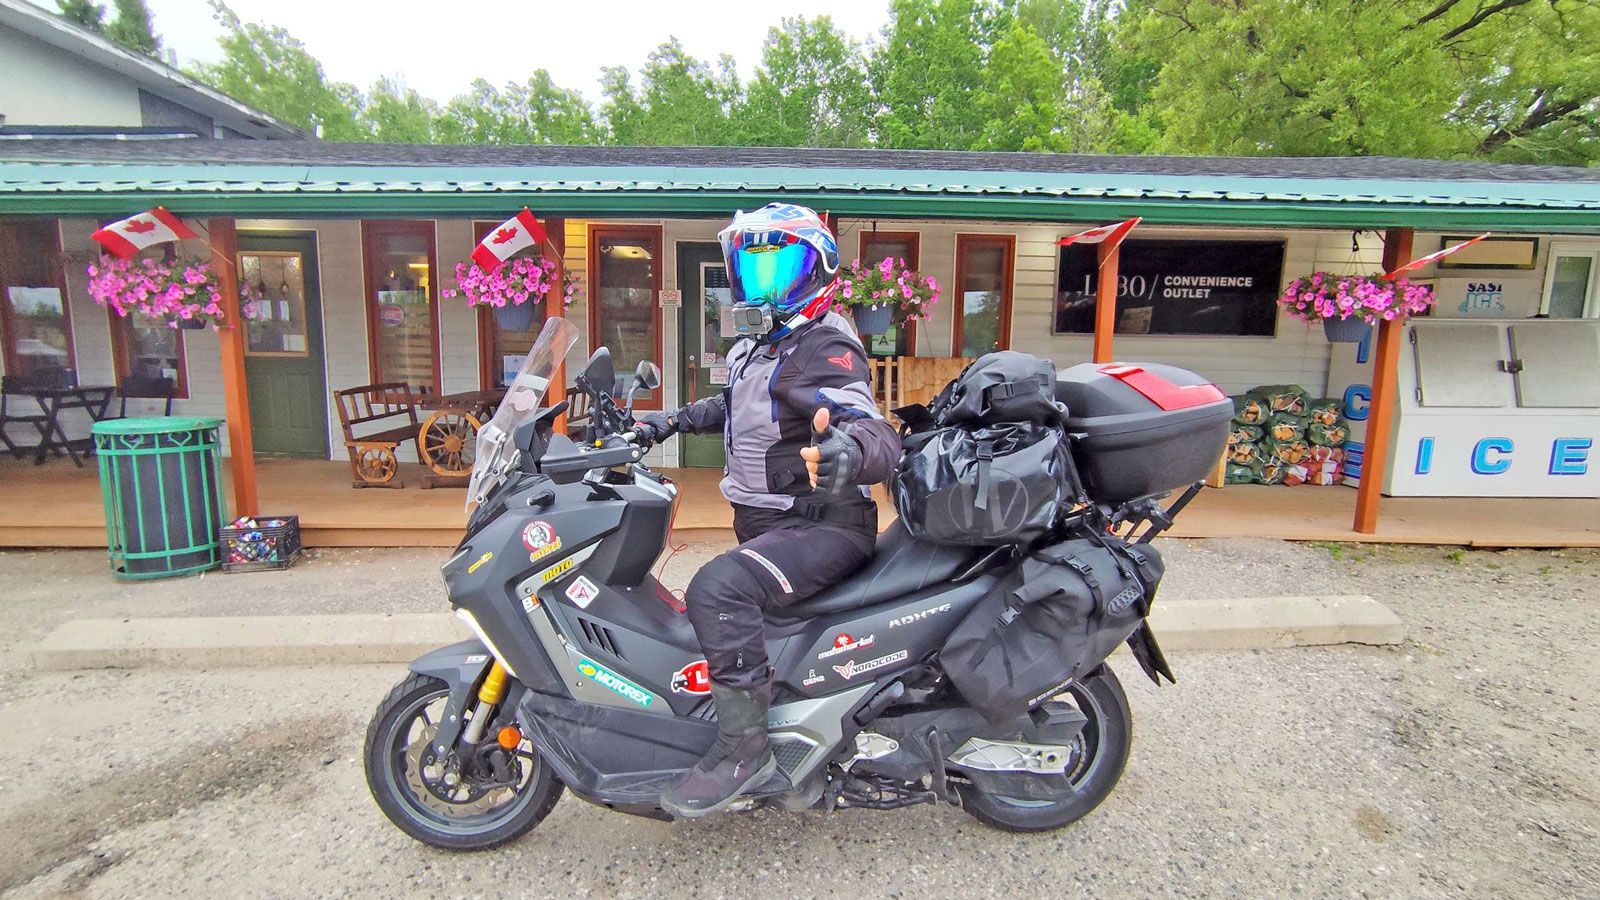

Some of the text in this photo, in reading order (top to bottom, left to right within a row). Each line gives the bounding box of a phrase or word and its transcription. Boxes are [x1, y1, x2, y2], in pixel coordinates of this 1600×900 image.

[1163, 288, 1211, 299] OUTLET
[1164, 276, 1253, 287] CONVENIENCE
[1415, 436, 1593, 476] ICE
[851, 650, 907, 675] NORDCODE
[594, 670, 652, 706] MOTOREX
